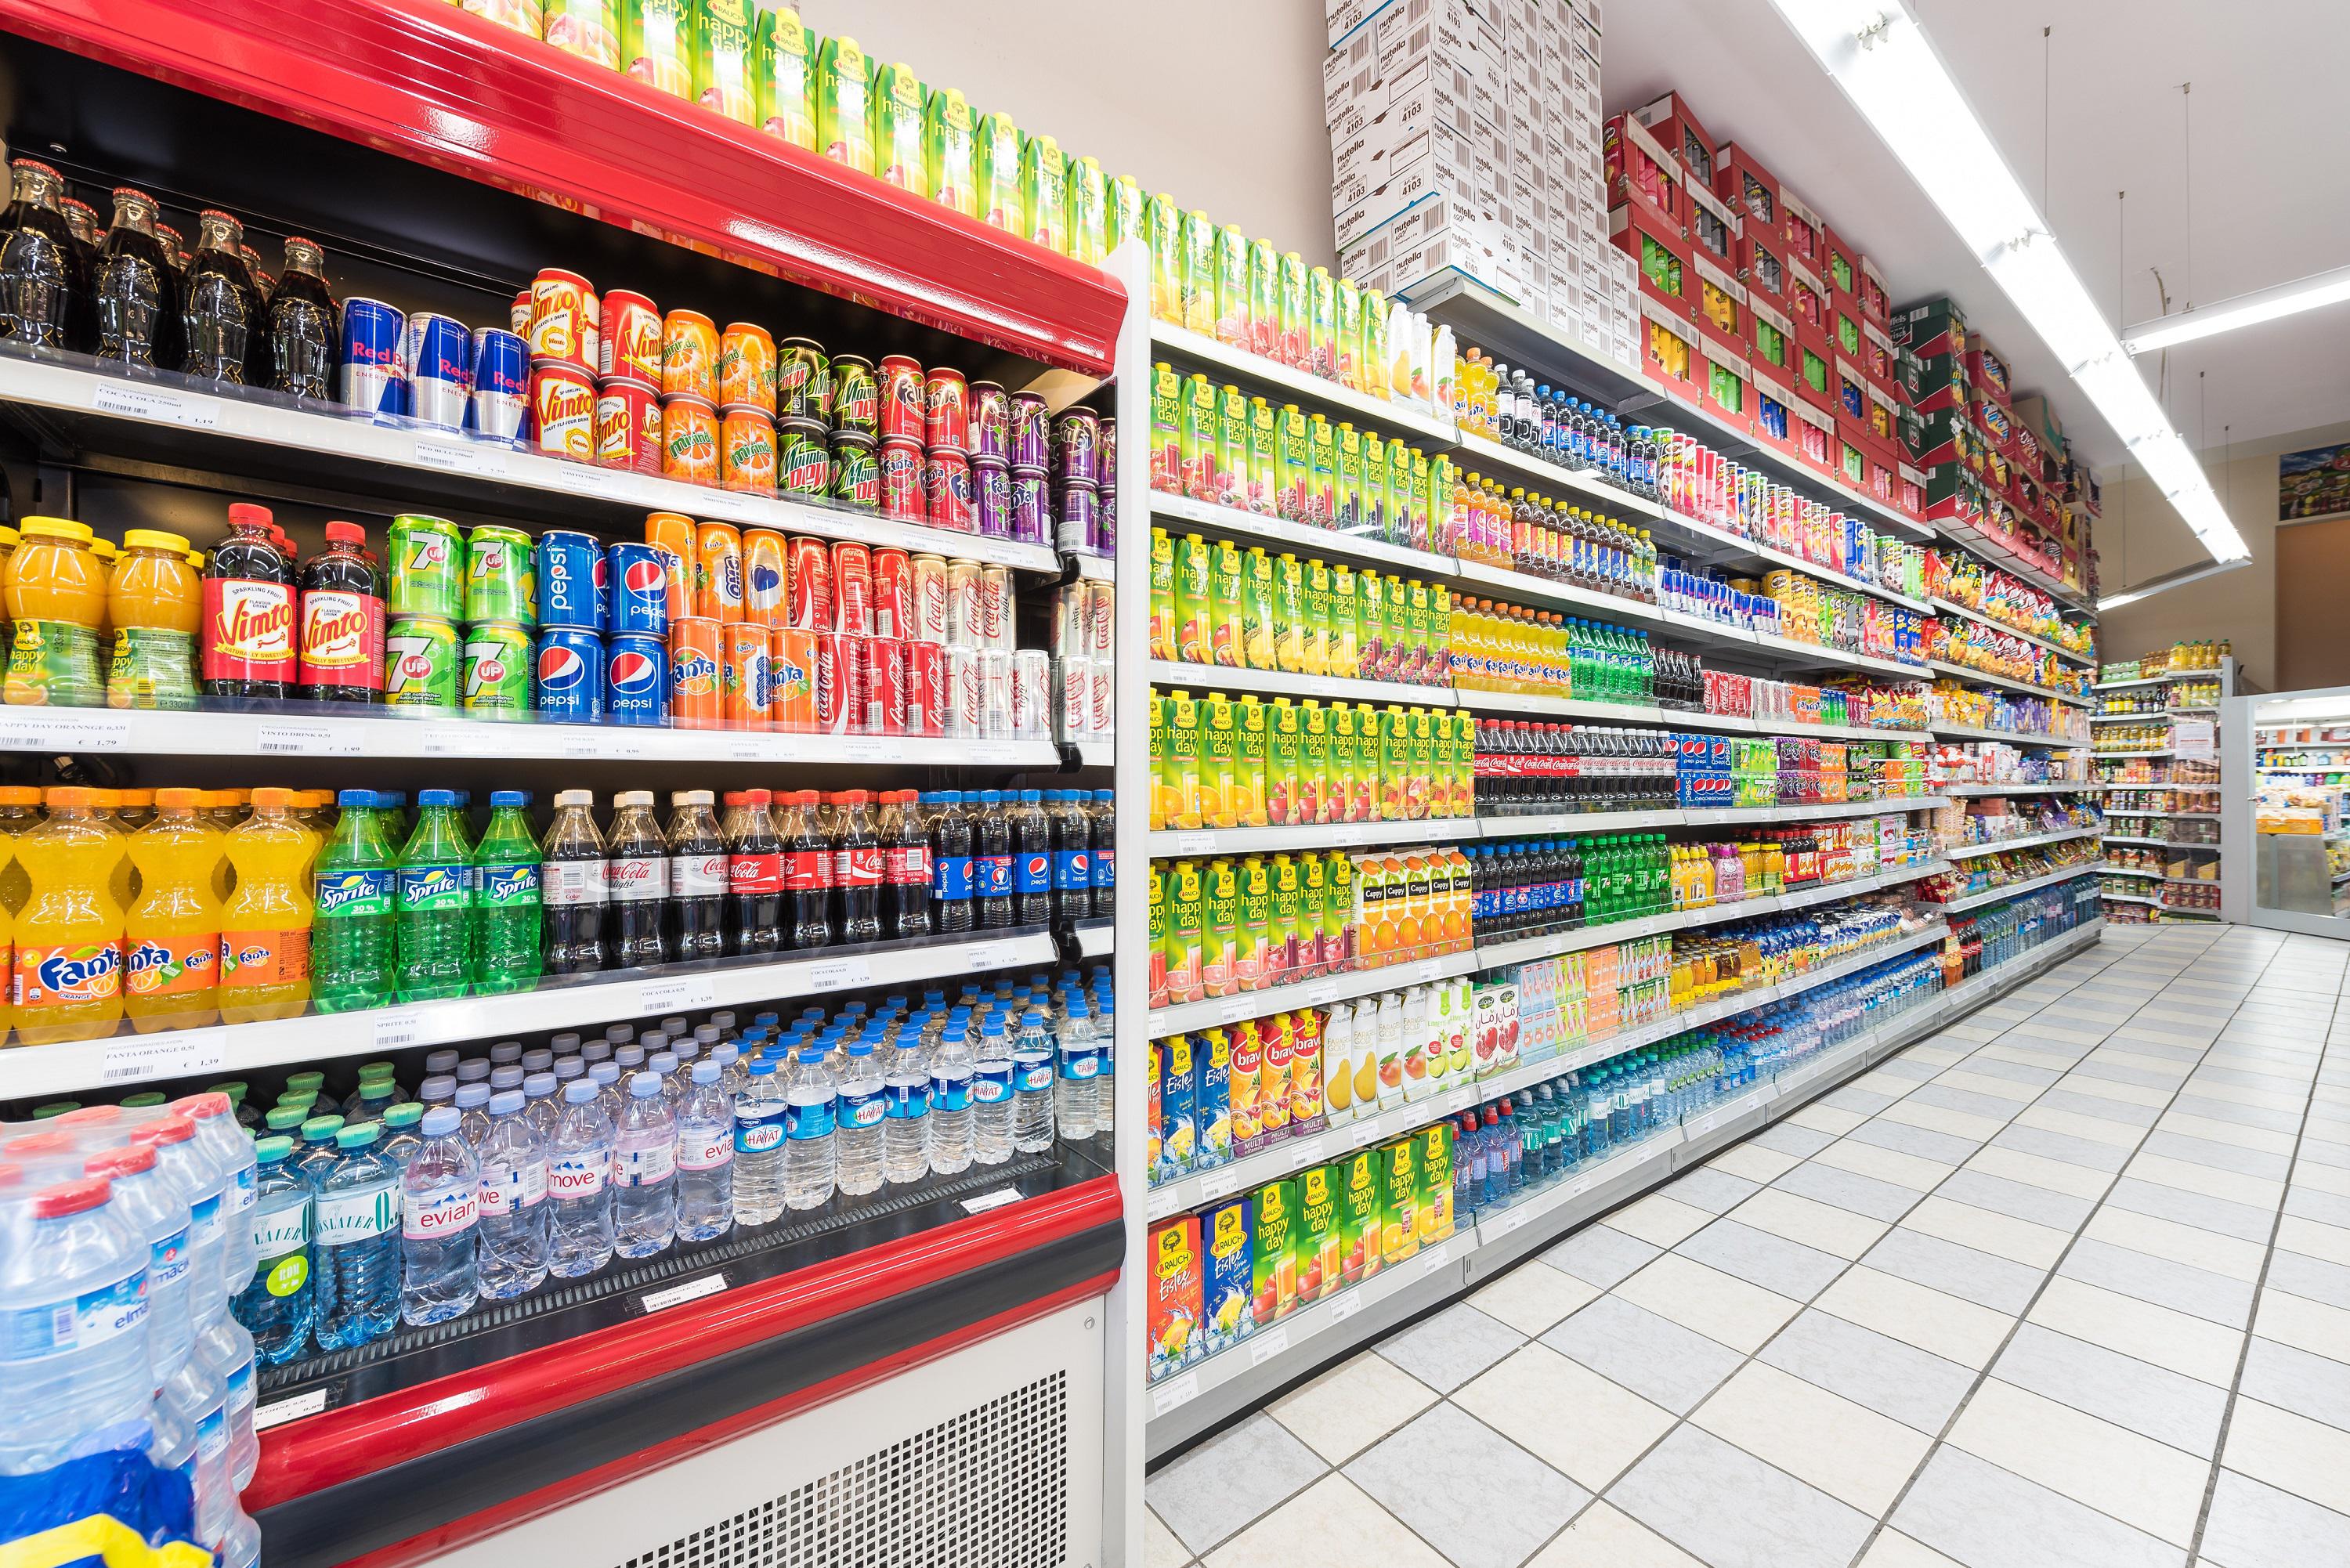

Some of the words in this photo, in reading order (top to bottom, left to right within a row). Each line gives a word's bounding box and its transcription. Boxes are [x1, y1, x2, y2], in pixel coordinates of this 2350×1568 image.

[1344, 11, 1362, 30] 4103
[1379, 5, 1405, 31] nutella
[1447, 12, 1462, 29] 4103
[699, 13, 753, 52] happy
[1438, 25, 1462, 49] nutella
[1325, 48, 1347, 70] nutella
[1380, 39, 1406, 64] nutella
[1326, 80, 1350, 103] nutella
[1402, 106, 1422, 122] 4103
[1346, 117, 1364, 135] 4103
[1337, 139, 1365, 164] nutella
[1347, 186, 1365, 203] 4103
[1402, 179, 1422, 196] 4103
[1453, 202, 1476, 222] nutella
[1338, 210, 1365, 233] nutella
[1394, 214, 1420, 234] nutella
[1502, 239, 1516, 253] 4103
[1396, 251, 1422, 271] nutella
[539, 284, 559, 297] SPARKLING
[352, 341, 390, 363] Red
[439, 359, 470, 381] Red
[494, 371, 526, 391] Red
[782, 369, 807, 390] DEW
[99, 388, 127, 399] COCA
[129, 395, 157, 404] COLA
[538, 385, 594, 425] Vimto
[544, 425, 556, 434] FRUIT
[557, 419, 577, 430] FLAVOUR
[572, 439, 588, 449] Vimto
[669, 432, 714, 459] mirinda
[730, 442, 773, 468] mirinda
[790, 461, 829, 490] DEW
[883, 460, 913, 475] Fanta
[409, 531, 446, 570] 7
[428, 549, 445, 559] UP
[472, 541, 505, 578] 7
[487, 556, 502, 565] UP
[547, 542, 573, 611] pepsi
[232, 587, 266, 595] SPARKLING
[267, 591, 282, 601] FRUIT
[309, 596, 337, 605] SPARKLING
[338, 598, 354, 609] FRUIT
[631, 605, 666, 619] pepsi
[999, 596, 1009, 621] light
[218, 598, 293, 646] Vimto
[302, 608, 367, 652] Vimto
[224, 646, 258, 659] NATURALLY
[260, 650, 290, 659] SWEETENED
[736, 642, 754, 652] Fanta
[13, 661, 36, 674] day
[328, 656, 361, 664] SWEETENED
[386, 636, 435, 695] 7
[405, 662, 429, 674] UP
[465, 641, 507, 698] 7
[481, 666, 502, 677] UP
[540, 695, 580, 707] pepsi
[613, 698, 653, 711] pepsi
[1176, 742, 1196, 757] day
[1685, 777, 1694, 802] pepsi
[492, 875, 537, 903] Sprite
[611, 879, 634, 891] light
[1387, 887, 1405, 896] Cappy
[1411, 883, 1428, 894] Cappy
[1434, 880, 1449, 891] Cappy
[1455, 878, 1470, 888] Cappy
[321, 882, 375, 913] Sprite
[405, 878, 455, 907] Sprite
[1365, 889, 1383, 899] Cappy
[1180, 912, 1201, 927] day
[185, 952, 213, 968] Fanta
[239, 949, 270, 965] Fanta
[40, 948, 122, 991] Fanta
[139, 1047, 179, 1057] ORANGE
[200, 1058, 219, 1067] 1,39
[1029, 1072, 1052, 1084] HAYAT
[974, 1086, 1000, 1097] HAYAT
[858, 1104, 884, 1121] HAYAT
[1303, 1119, 1324, 1129] MULTI
[1303, 1125, 1322, 1134] vitamin
[747, 1130, 779, 1145] HAYAT
[1244, 1138, 1264, 1150] MULTI
[1245, 1146, 1263, 1155] vitamin
[1431, 1145, 1444, 1155] RAUCH
[1397, 1161, 1411, 1172] RAUCH
[1424, 1155, 1448, 1173] happy
[550, 1171, 595, 1188] move
[1355, 1175, 1369, 1186] RAUCH
[1390, 1172, 1415, 1190] happy
[1430, 1169, 1445, 1184] day
[1311, 1190, 1327, 1201] RAUCH
[1348, 1185, 1376, 1205] happy
[1396, 1184, 1411, 1200] day
[420, 1199, 475, 1228] evian
[1267, 1206, 1282, 1219] RAUCH
[1303, 1201, 1334, 1222] happy
[1355, 1200, 1373, 1216] day
[1258, 1217, 1289, 1241] happy
[1311, 1216, 1329, 1233] day
[1220, 1234, 1242, 1250] RAUCH
[1266, 1234, 1285, 1252] day
[1165, 1253, 1189, 1268] RAUCH
[1215, 1246, 1243, 1280] EisTee
[1160, 1267, 1190, 1302] EisTee
